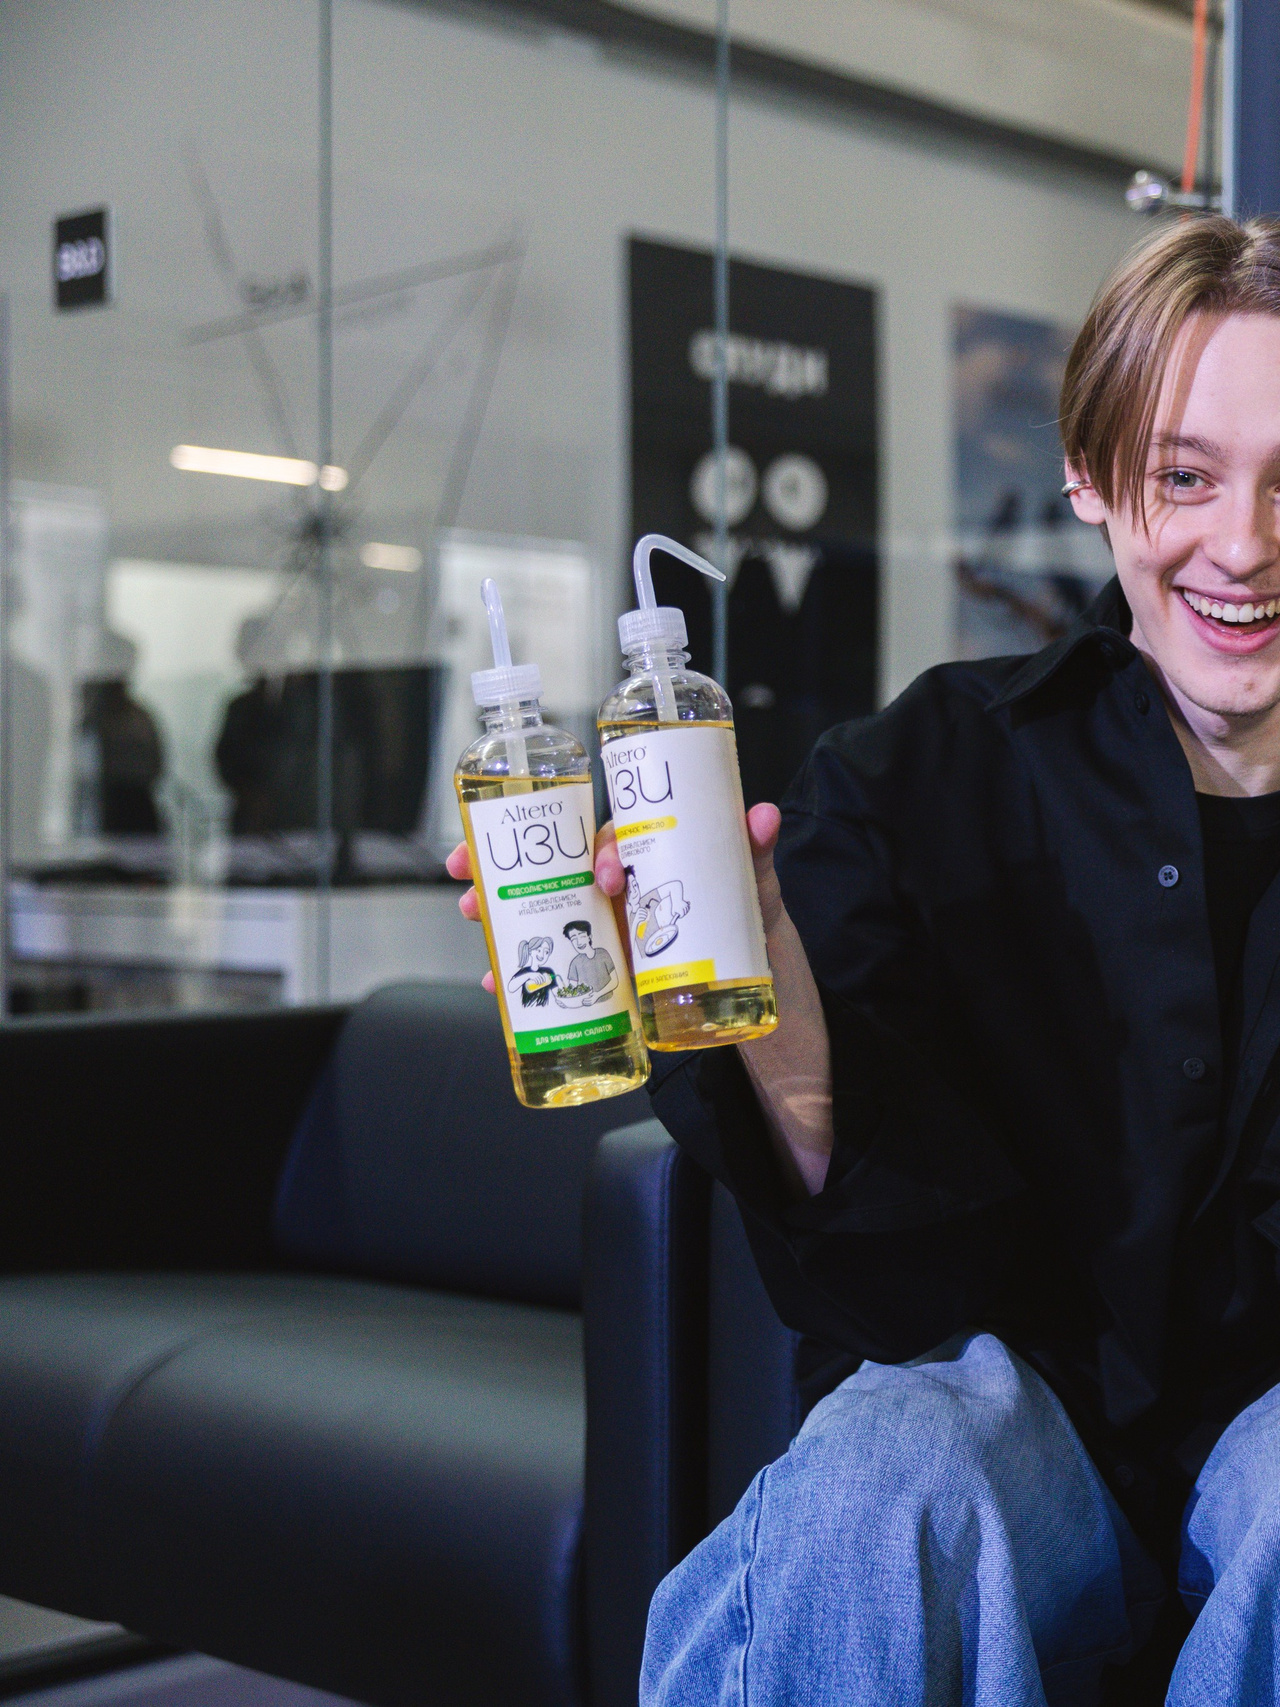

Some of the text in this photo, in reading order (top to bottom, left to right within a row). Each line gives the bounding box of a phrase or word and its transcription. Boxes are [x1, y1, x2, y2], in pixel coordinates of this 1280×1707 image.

[501, 801, 563, 825] Altero
[487, 815, 590, 871] ИЗИ
[507, 876, 586, 897] ПОДСОЛНЕЧНОЕ МАСЛО
[529, 893, 577, 908] ДОБАВЛЕНИЕМ
[566, 899, 582, 908] ТРАВ
[535, 1024, 614, 1046] ДЛЯ ЗАПРАВКИ САЛАТОВ
